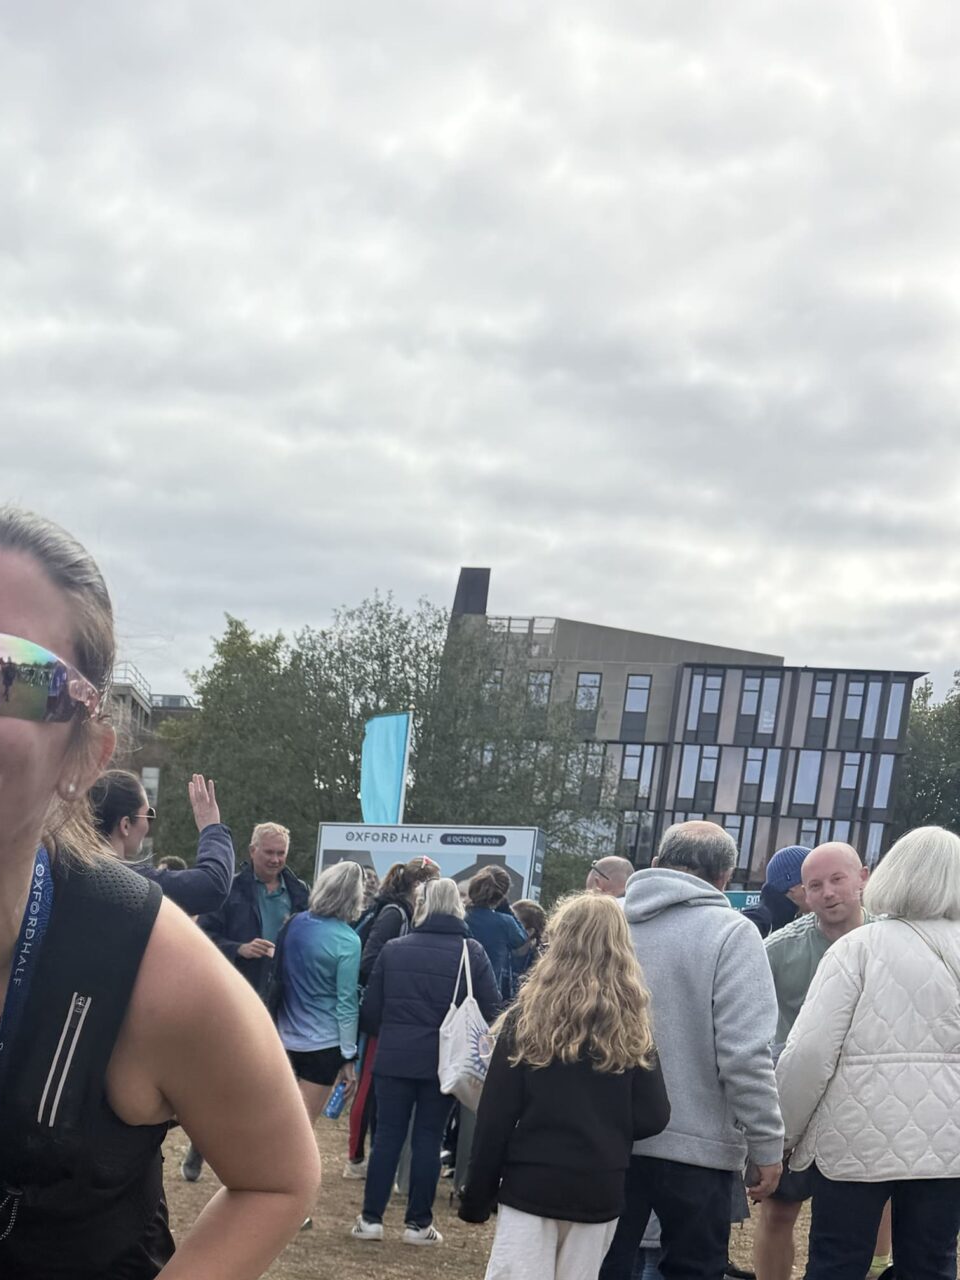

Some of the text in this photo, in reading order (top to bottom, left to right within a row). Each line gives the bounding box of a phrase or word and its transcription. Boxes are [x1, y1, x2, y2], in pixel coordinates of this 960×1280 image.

[345, 831, 434, 844] OXFORD HALF
[452, 836, 482, 844] OCTOBER
